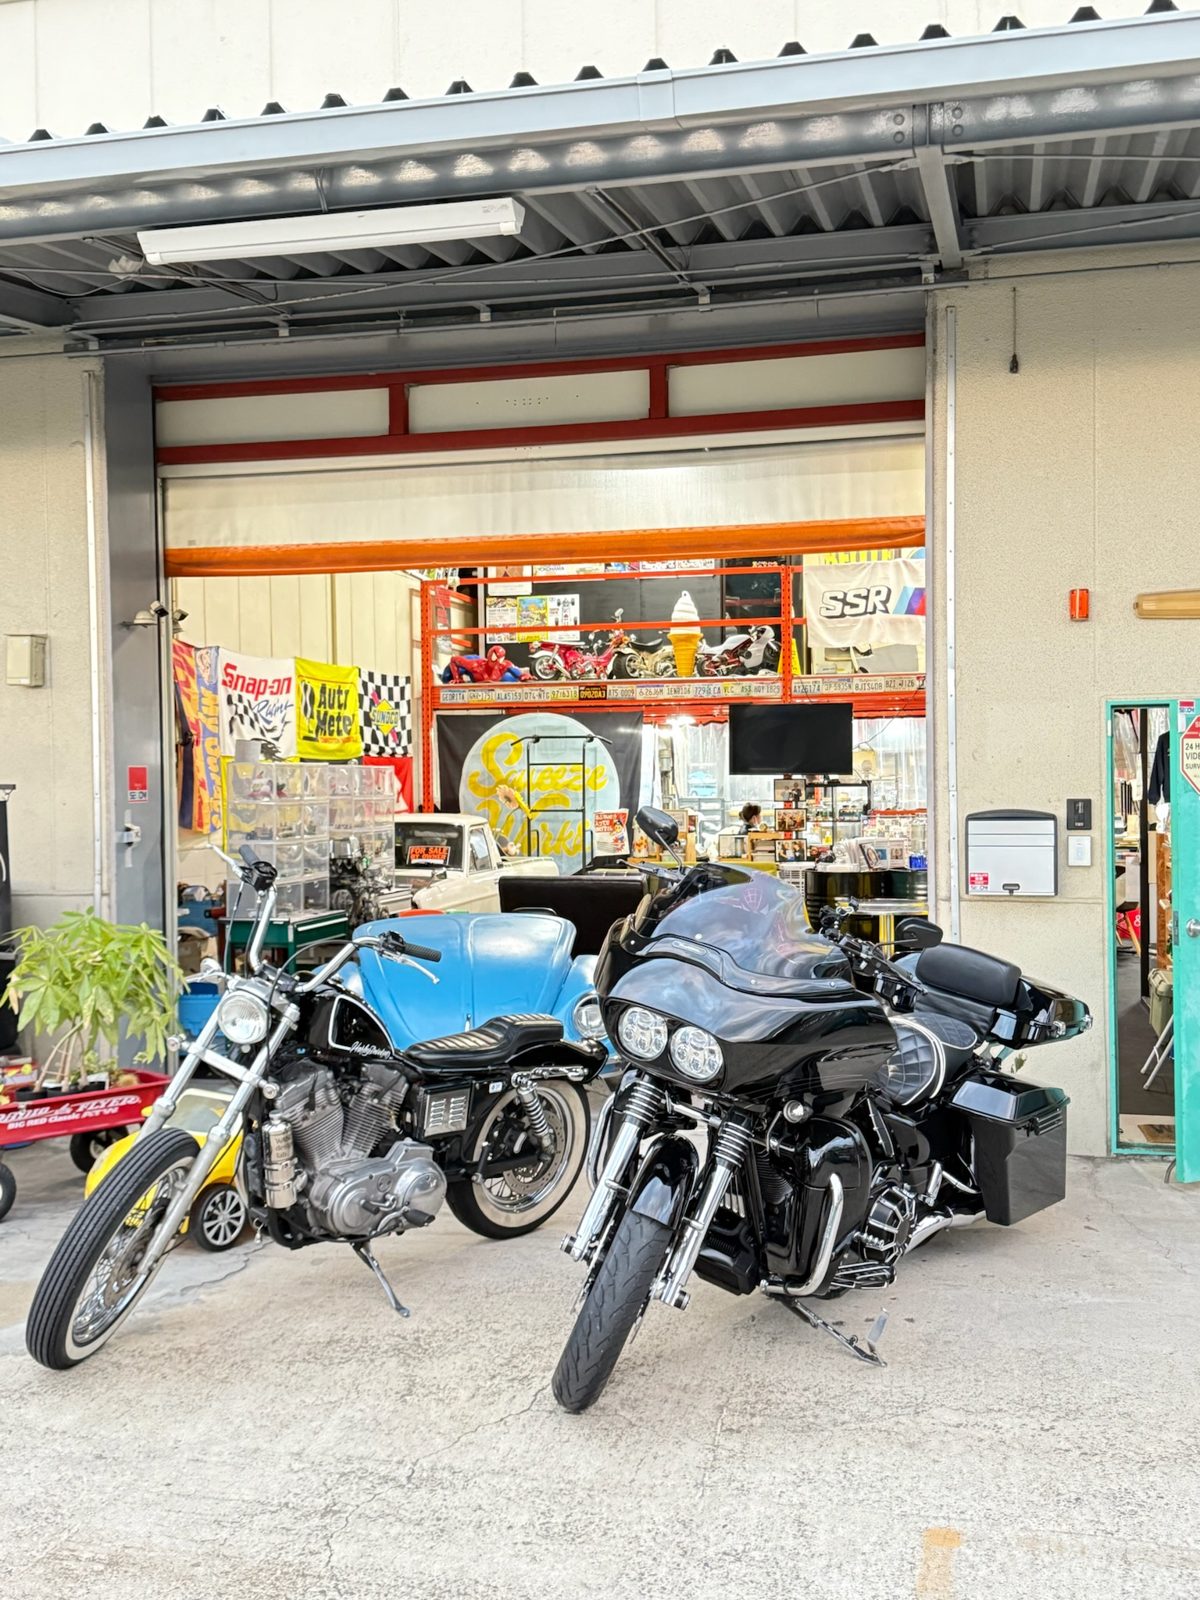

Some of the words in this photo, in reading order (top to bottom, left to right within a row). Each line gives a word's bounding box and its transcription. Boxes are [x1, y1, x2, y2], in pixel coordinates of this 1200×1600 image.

[819, 585, 892, 619] SSR
[221, 662, 292, 701] Snap-on
[371, 708, 399, 726] SUNOCO
[1185, 743, 1194, 751] 24
[411, 847, 425, 855] FOR
[428, 847, 448, 855] SALE
[7, 1120, 26, 1130] BIG
[26, 1117, 48, 1127] RED
[48, 1113, 81, 1124] Classic
